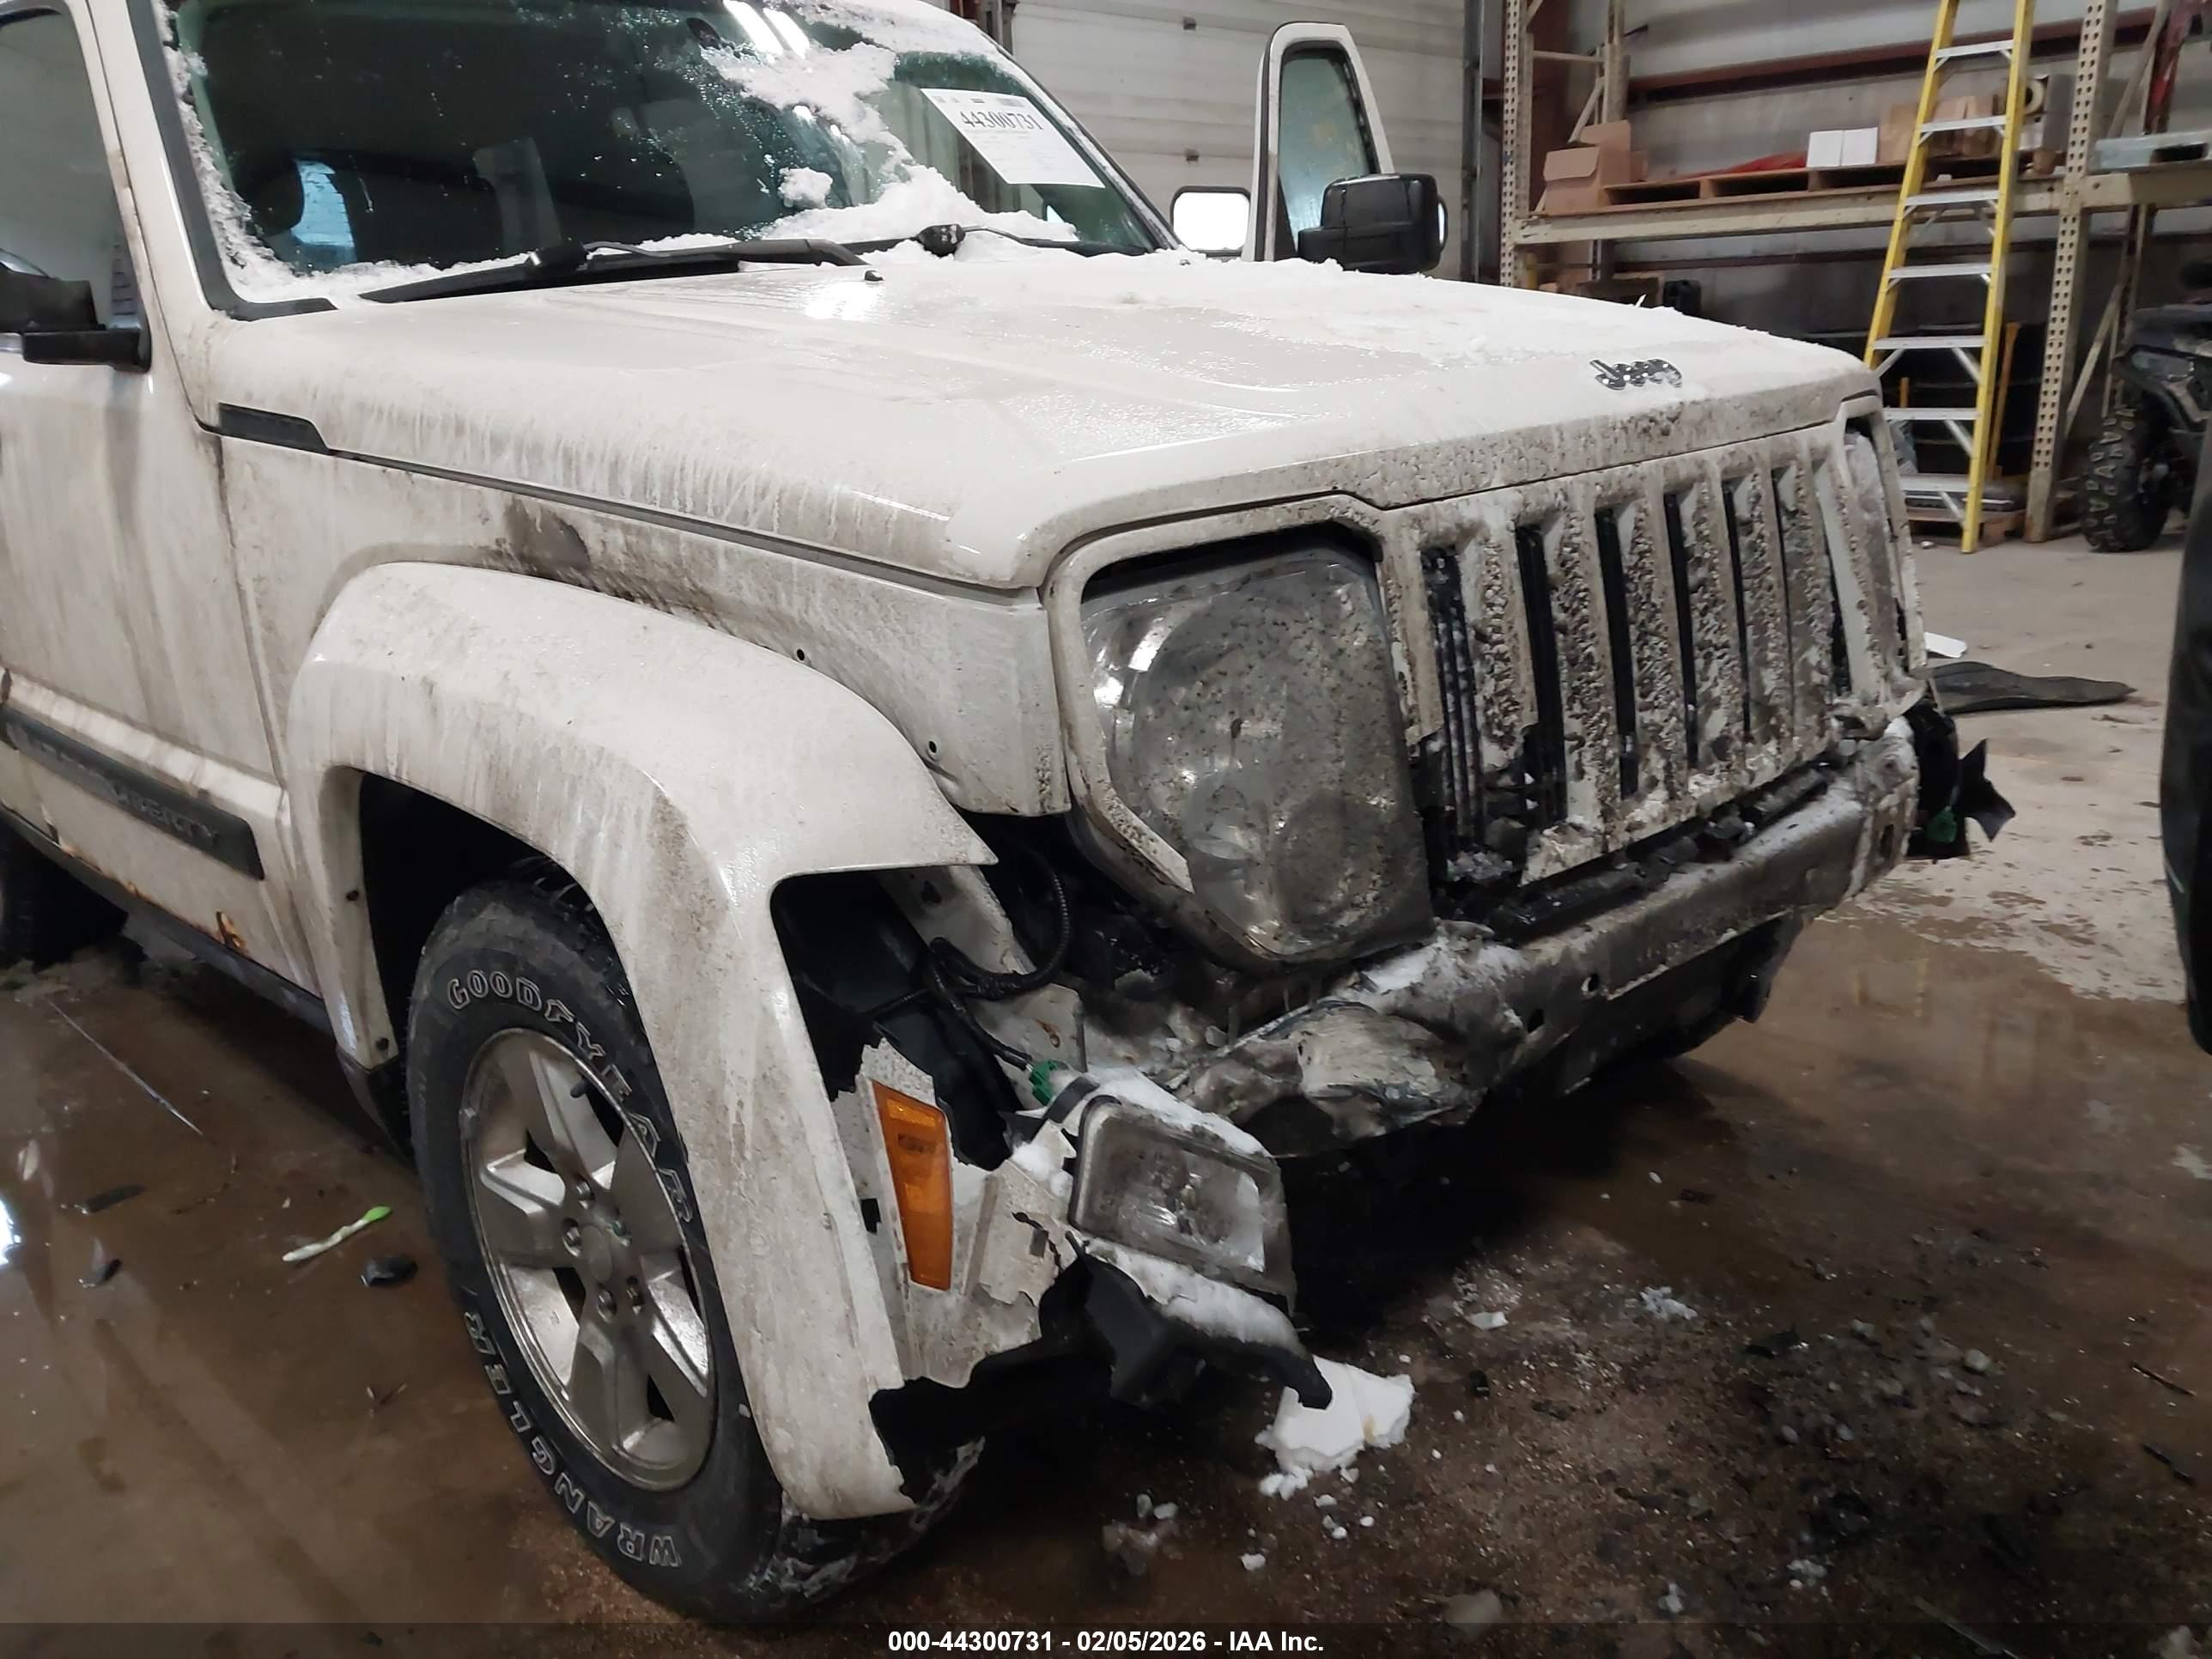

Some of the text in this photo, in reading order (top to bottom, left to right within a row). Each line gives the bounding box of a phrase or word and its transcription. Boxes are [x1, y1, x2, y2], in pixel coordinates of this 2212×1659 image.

[960, 111, 1044, 131] 44300731
[1589, 359, 1682, 391] Jeep
[464, 1312, 682, 1567] WRANGLER
